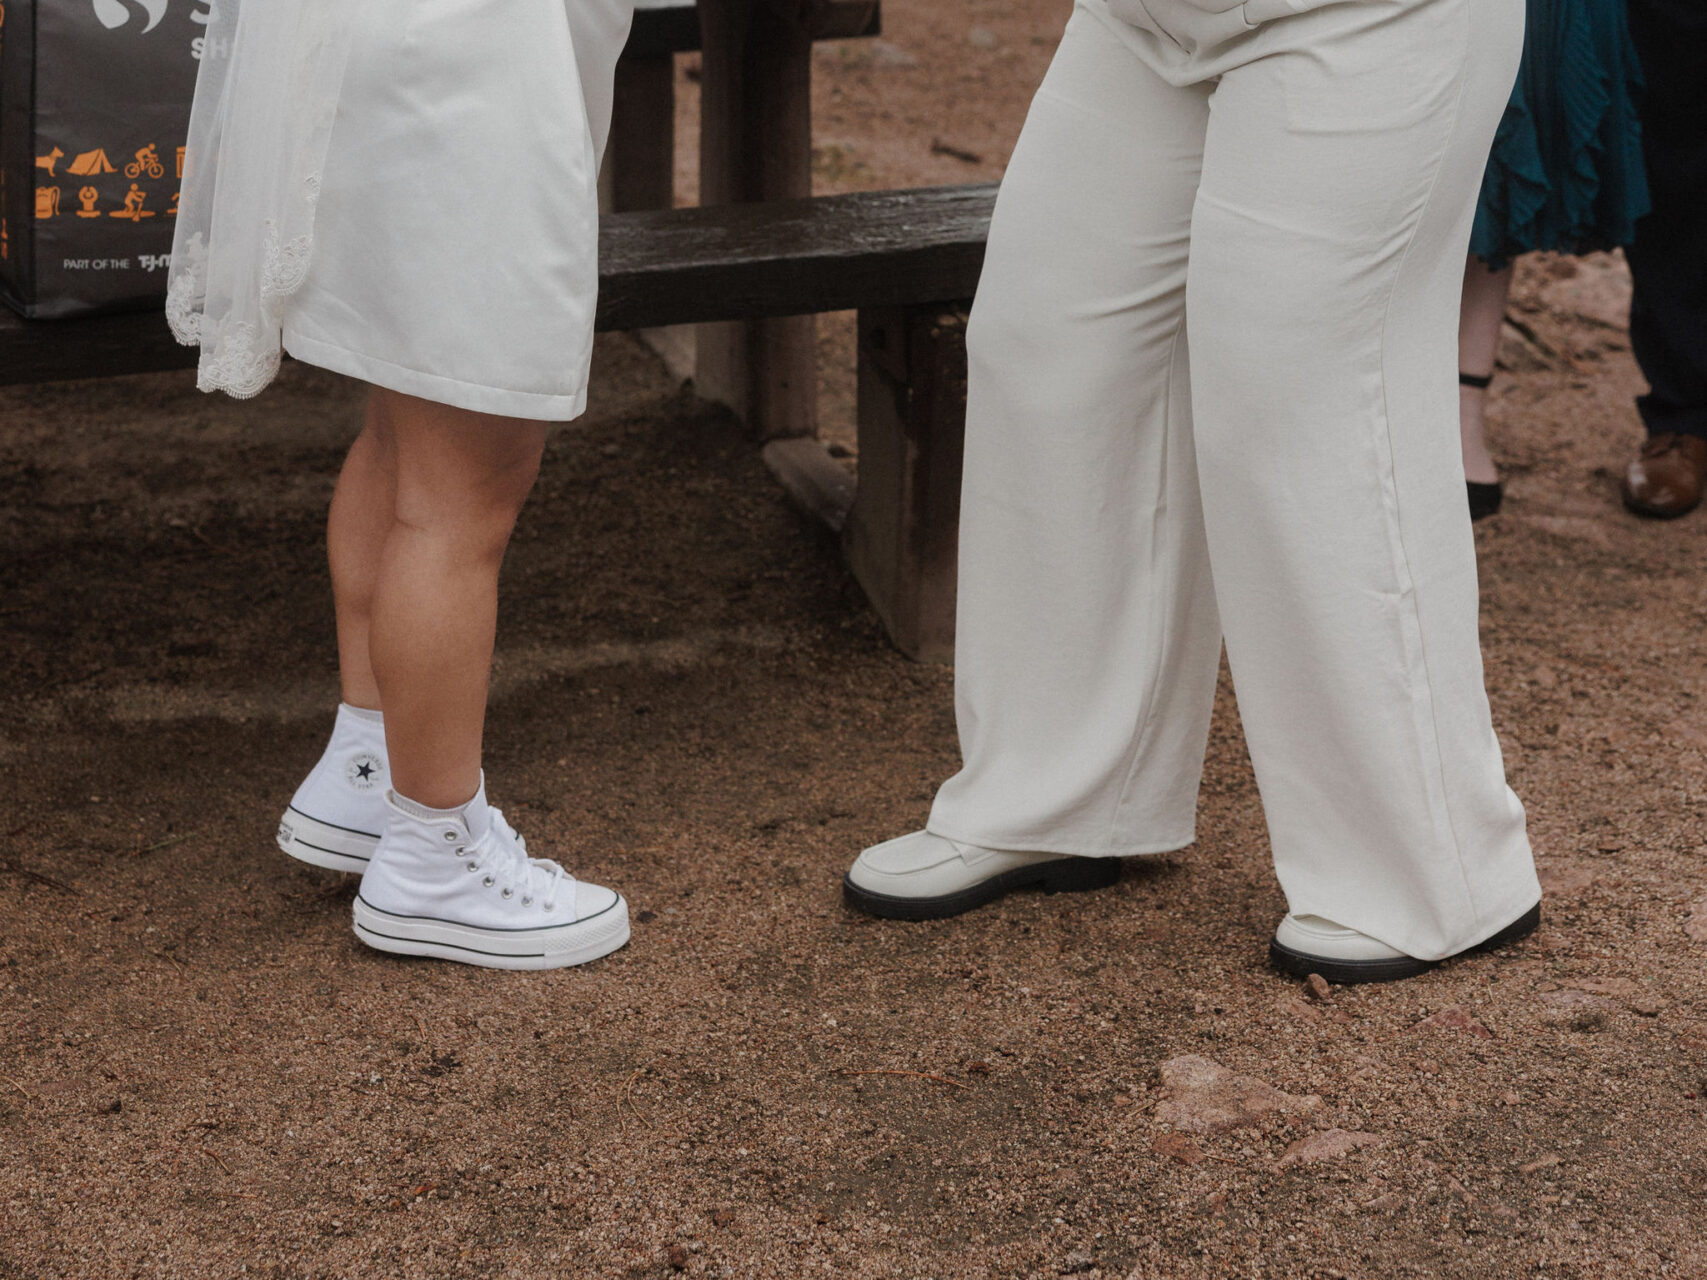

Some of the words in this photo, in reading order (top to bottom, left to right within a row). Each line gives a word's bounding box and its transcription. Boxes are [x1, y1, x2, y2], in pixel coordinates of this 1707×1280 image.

[63, 258, 90, 270] PART
[92, 258, 109, 270] OF
[110, 258, 130, 269] THE
